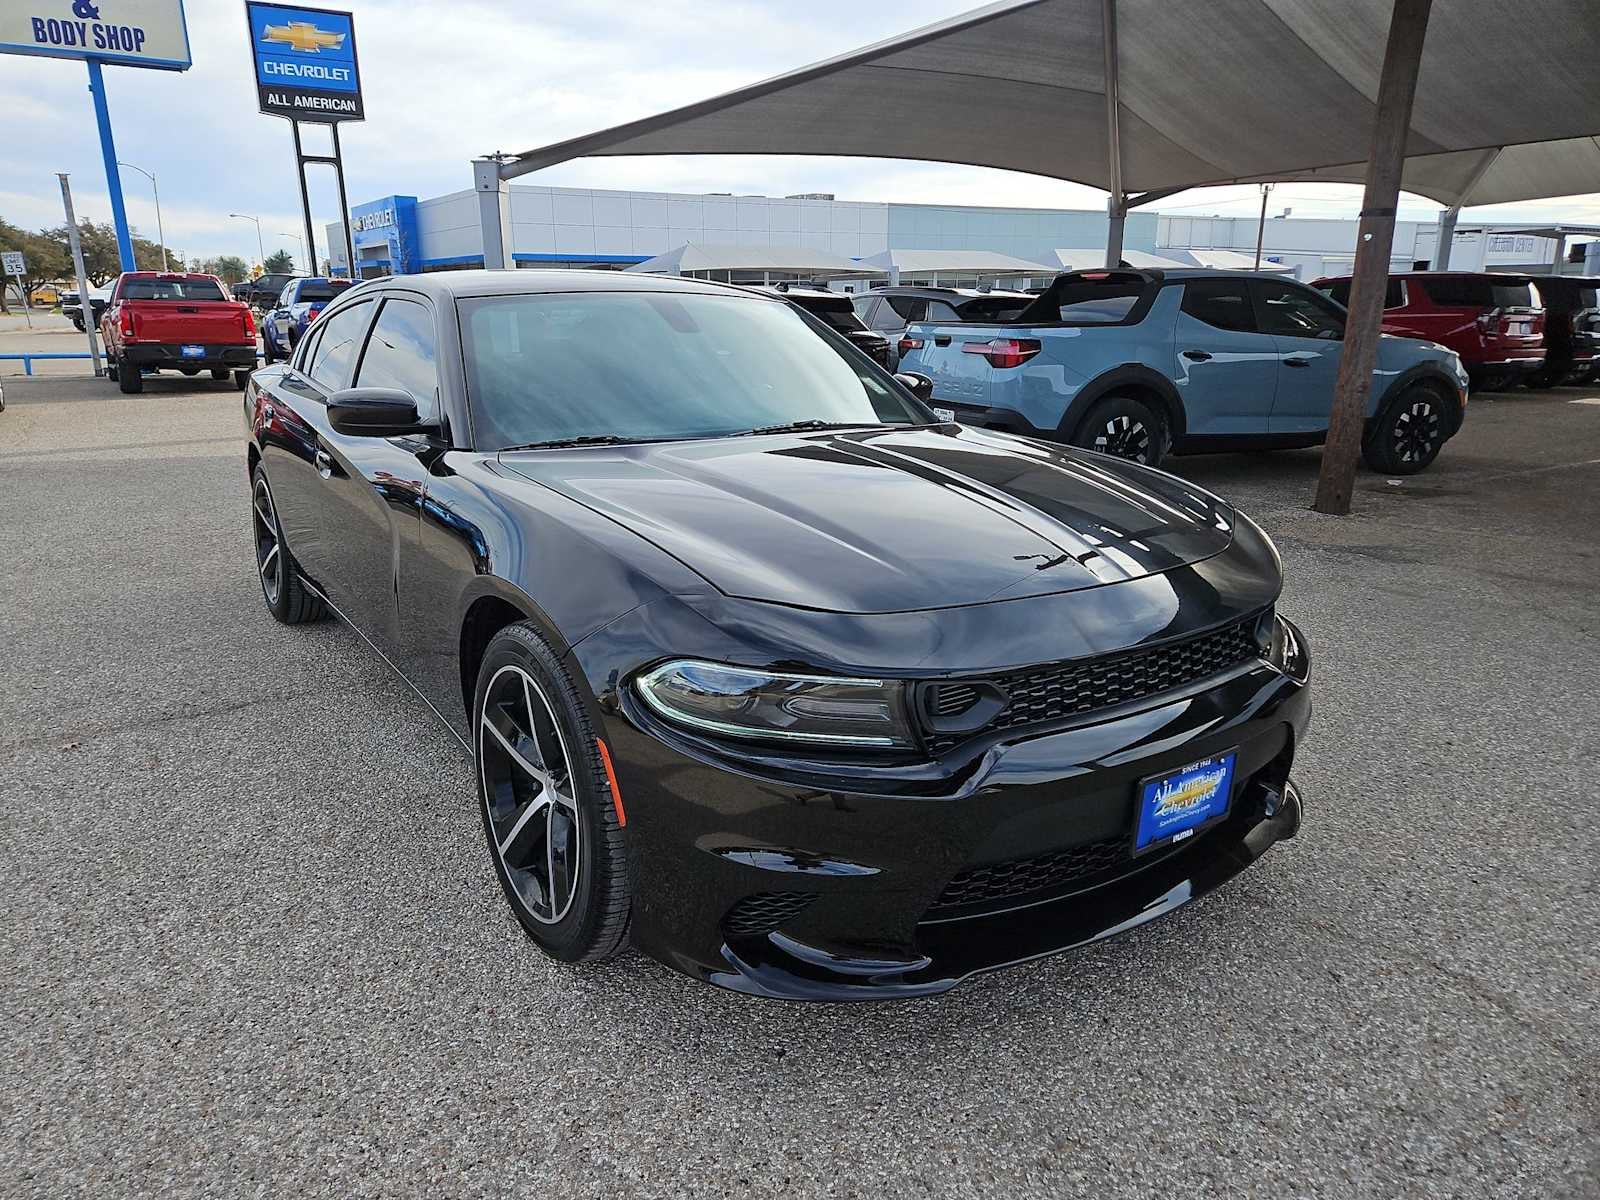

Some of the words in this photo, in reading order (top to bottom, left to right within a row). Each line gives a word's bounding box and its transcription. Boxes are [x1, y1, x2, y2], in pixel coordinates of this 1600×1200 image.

[31, 17, 87, 47] BODY
[92, 23, 145, 52] SHOP
[263, 61, 350, 81] CHEVROLET
[267, 93, 291, 106] ALL
[294, 95, 356, 111] AMERICAN
[7, 264, 23, 273] 35
[1182, 763, 1199, 774] SINCE
[1152, 783, 1172, 803] All
[1177, 767, 1227, 792] American
[1160, 786, 1217, 817] Chevrolet
